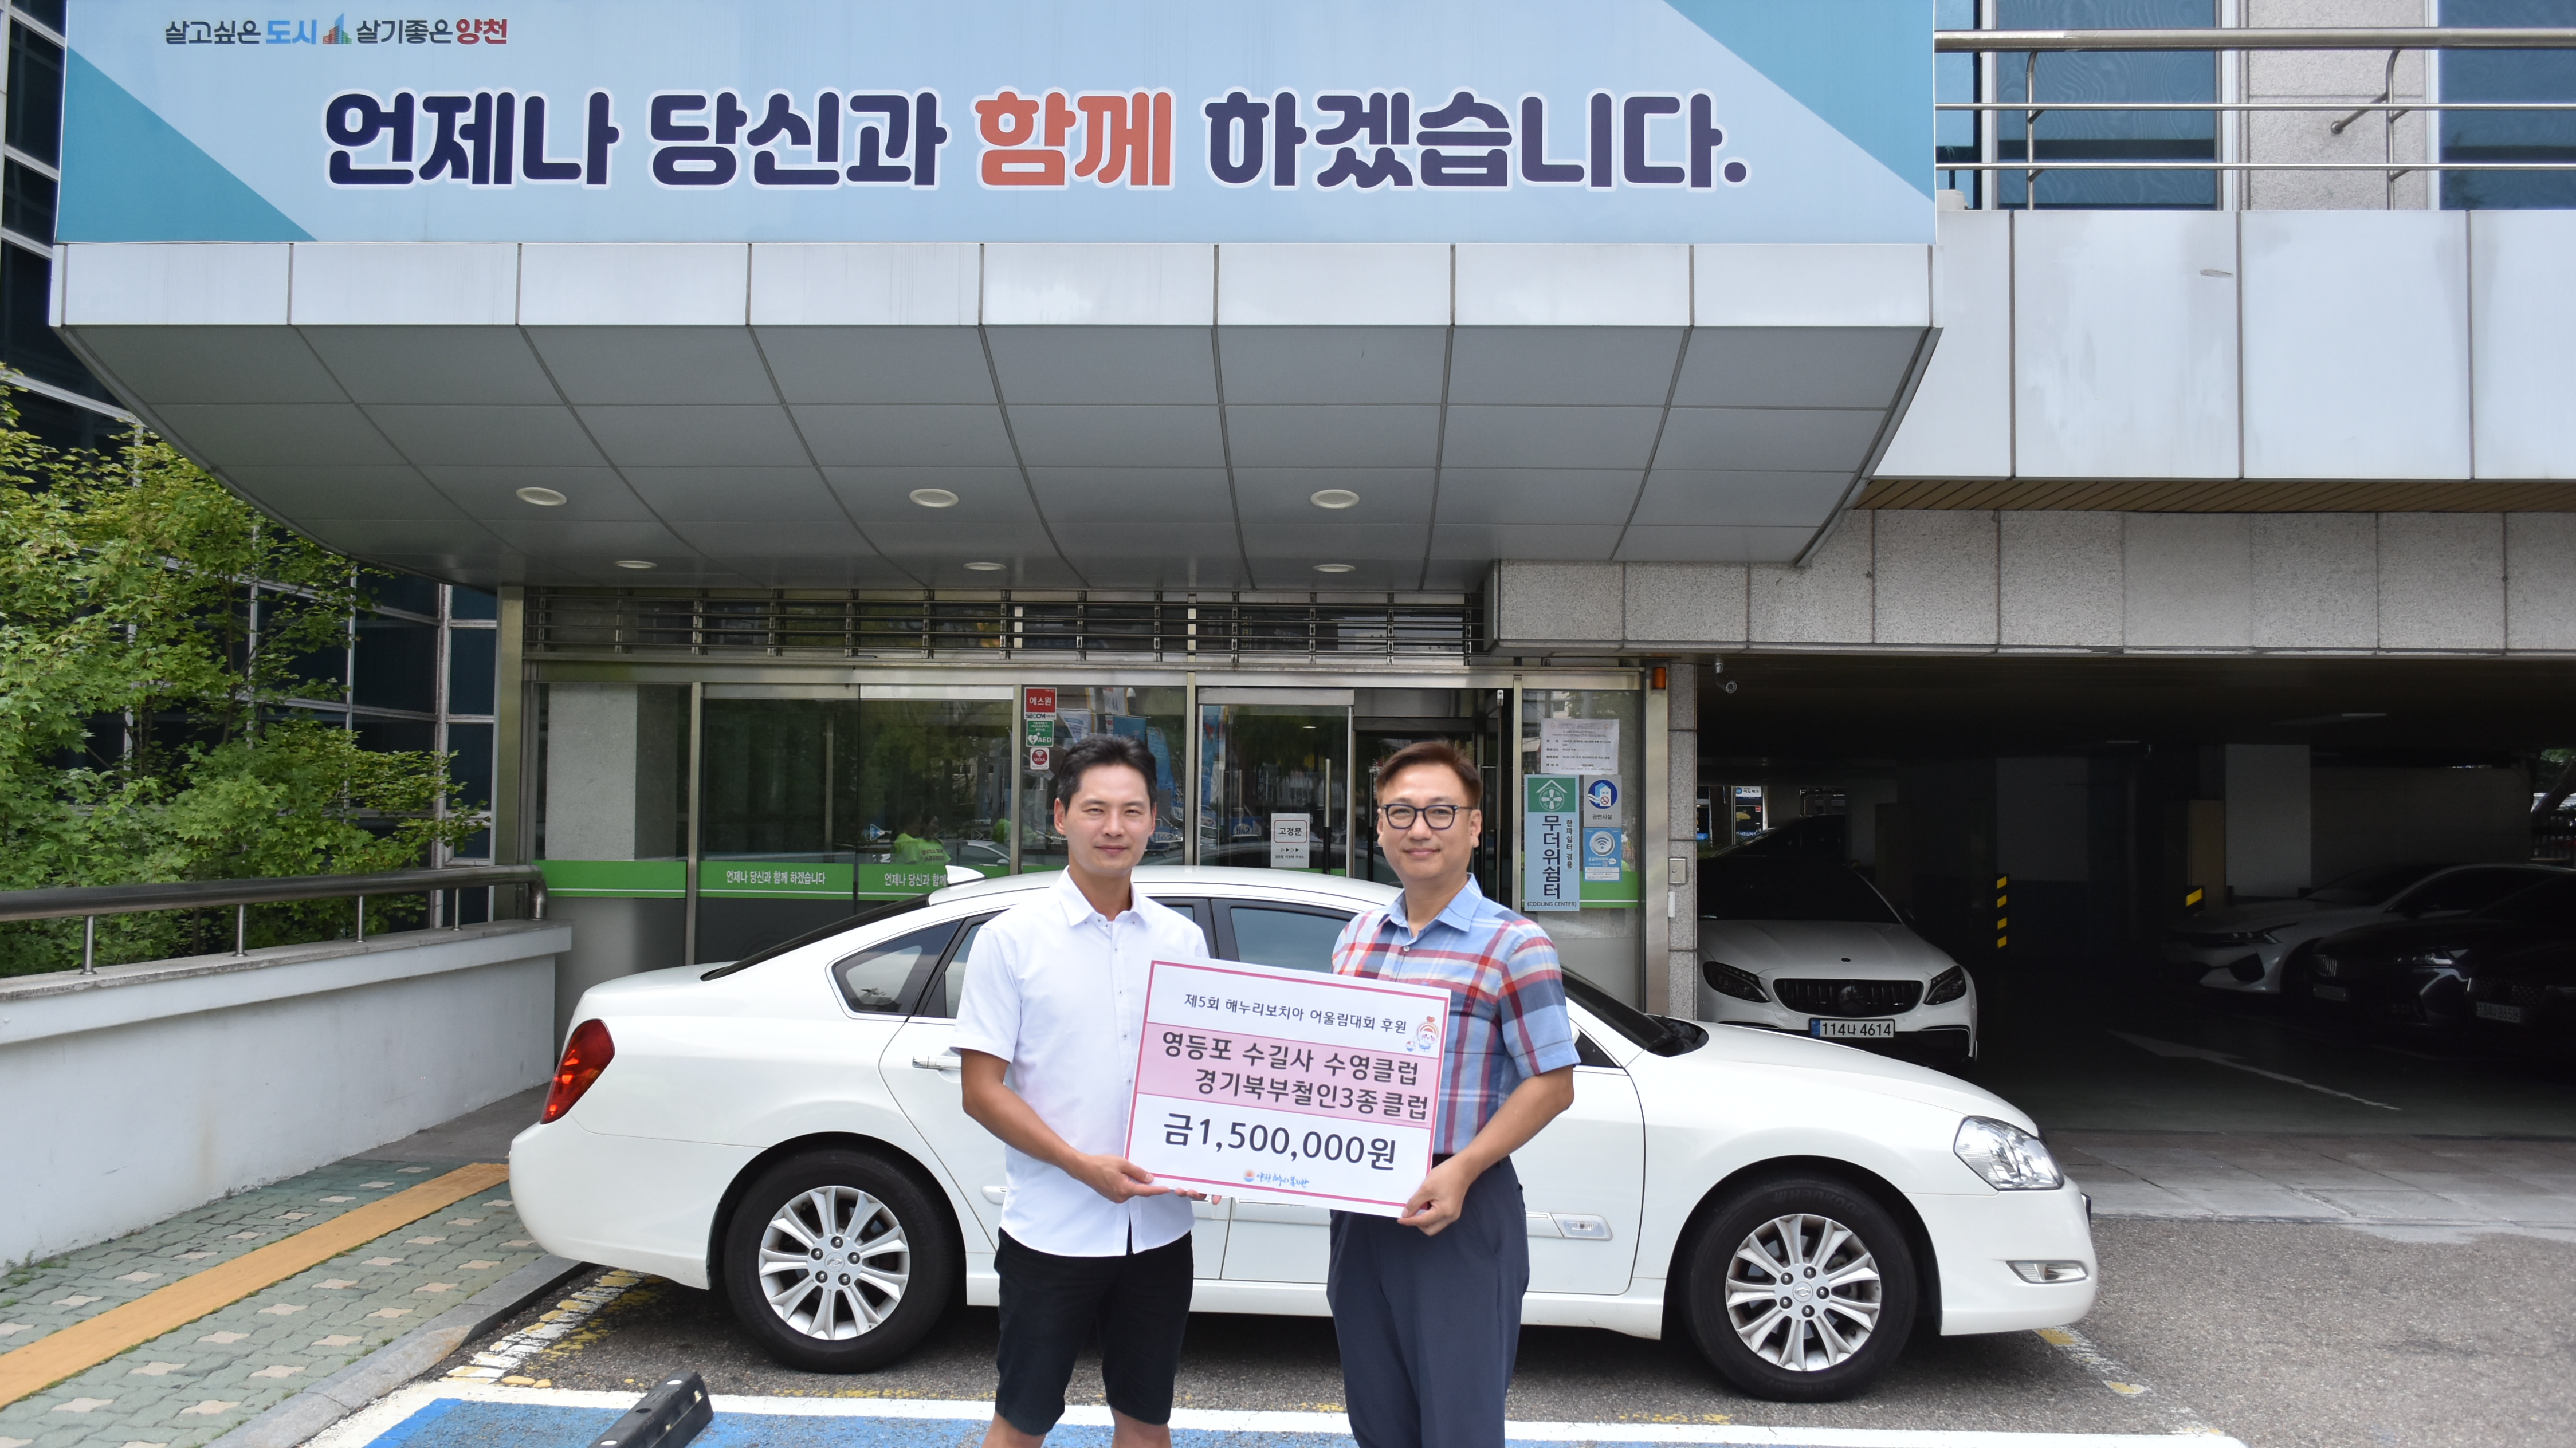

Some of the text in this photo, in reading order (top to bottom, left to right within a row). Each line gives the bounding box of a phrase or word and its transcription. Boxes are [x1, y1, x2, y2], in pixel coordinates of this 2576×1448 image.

[164, 18, 508, 46] 살고싶은 도시 살기좋은 양천
[325, 90, 1749, 189] 언제나 당신과 함께 하겠습니다.
[1029, 697, 1051, 706] 에스원
[1278, 827, 1302, 836] 고정문
[1542, 815, 1562, 899] 무더위쉼터
[1566, 853, 1573, 869] 겸용
[726, 870, 826, 886] 언제나 당신과 함께 하겠습니다
[885, 873, 947, 887] 언제나 당신과 함께
[1184, 993, 1407, 1034] 제5회 해누리보치아 어울림대회 후원
[1822, 1022, 1891, 1036] 114나 4614
[1162, 1032, 1419, 1086] 영등포 수길사 수영클럽
[1195, 1068, 1428, 1121] 경기북부철인3종클럽
[1163, 1112, 1396, 1171] 금1,500,000원
[1256, 1172, 1310, 1189] 양천 해누리 복지관
